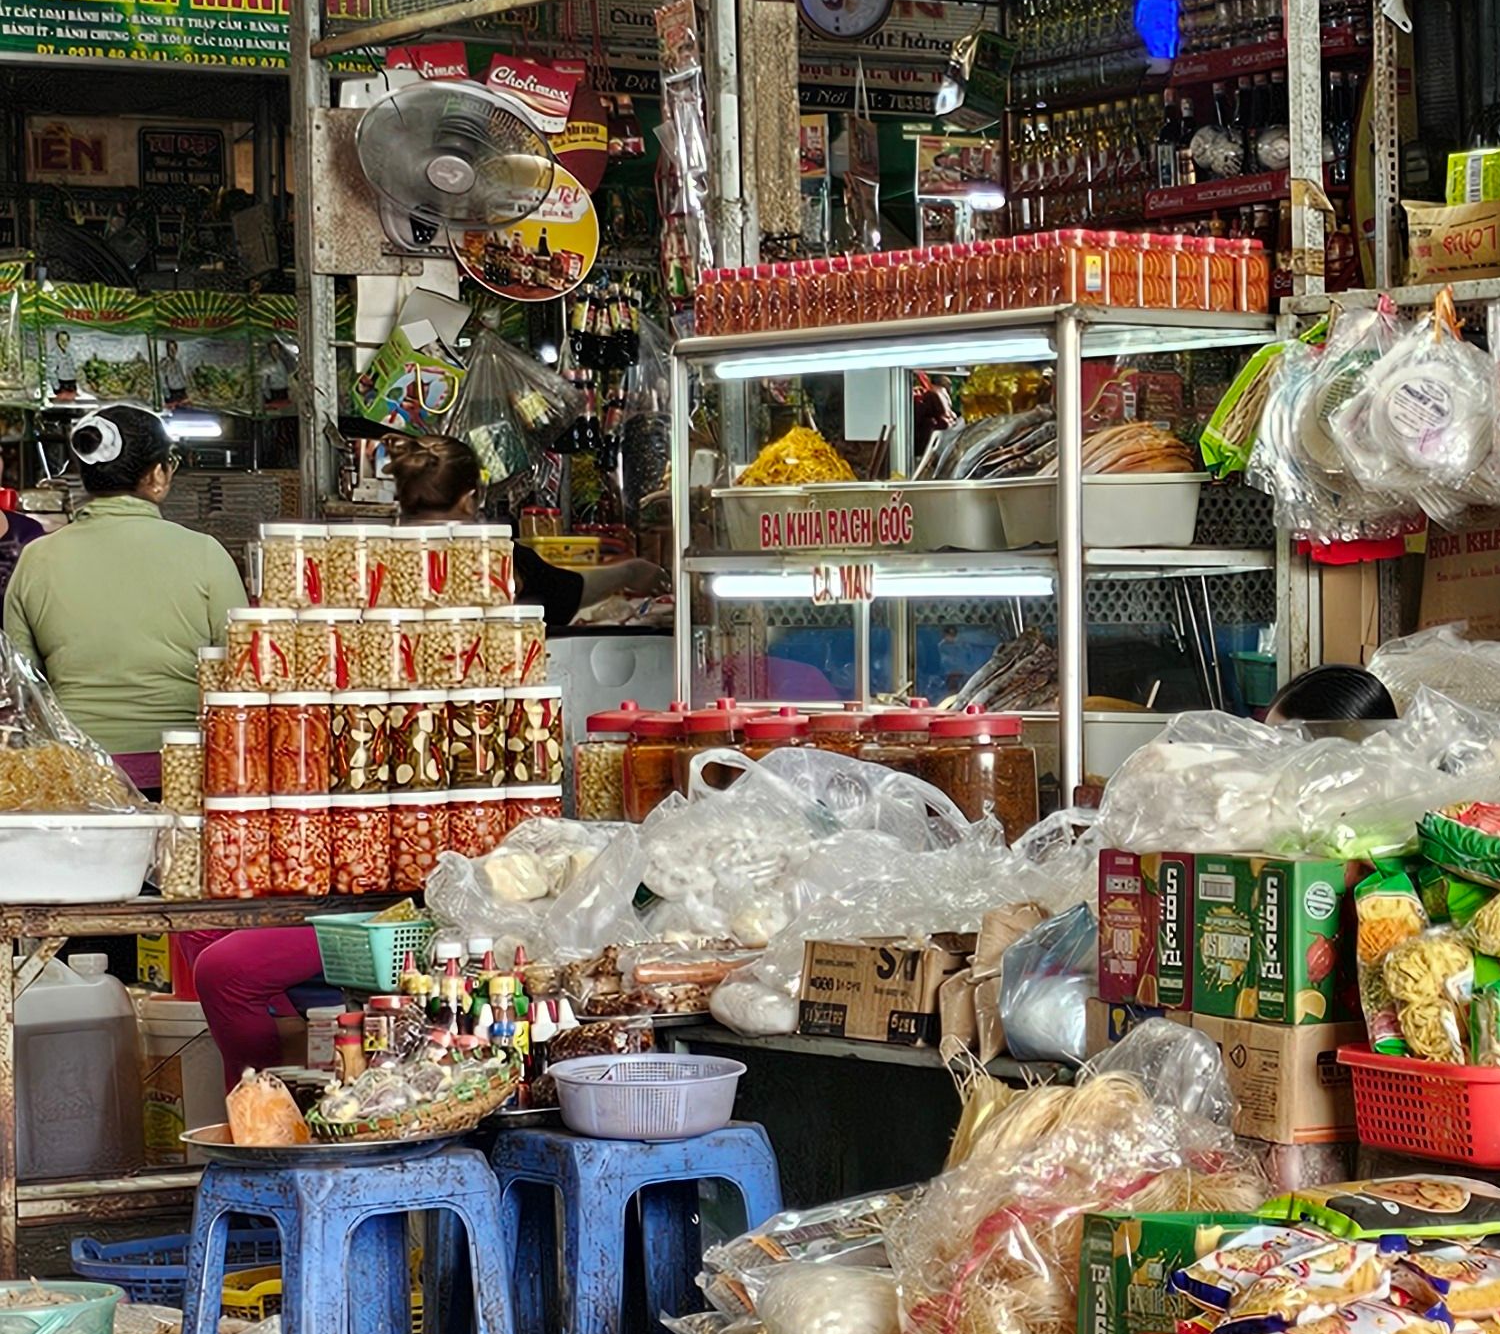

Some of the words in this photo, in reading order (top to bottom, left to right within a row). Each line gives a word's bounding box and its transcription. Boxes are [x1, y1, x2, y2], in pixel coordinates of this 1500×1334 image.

[490, 65, 571, 105] Cholimex
[760, 513, 783, 550] BA
[878, 490, 914, 546] GỐC
[838, 563, 876, 604] MAU
